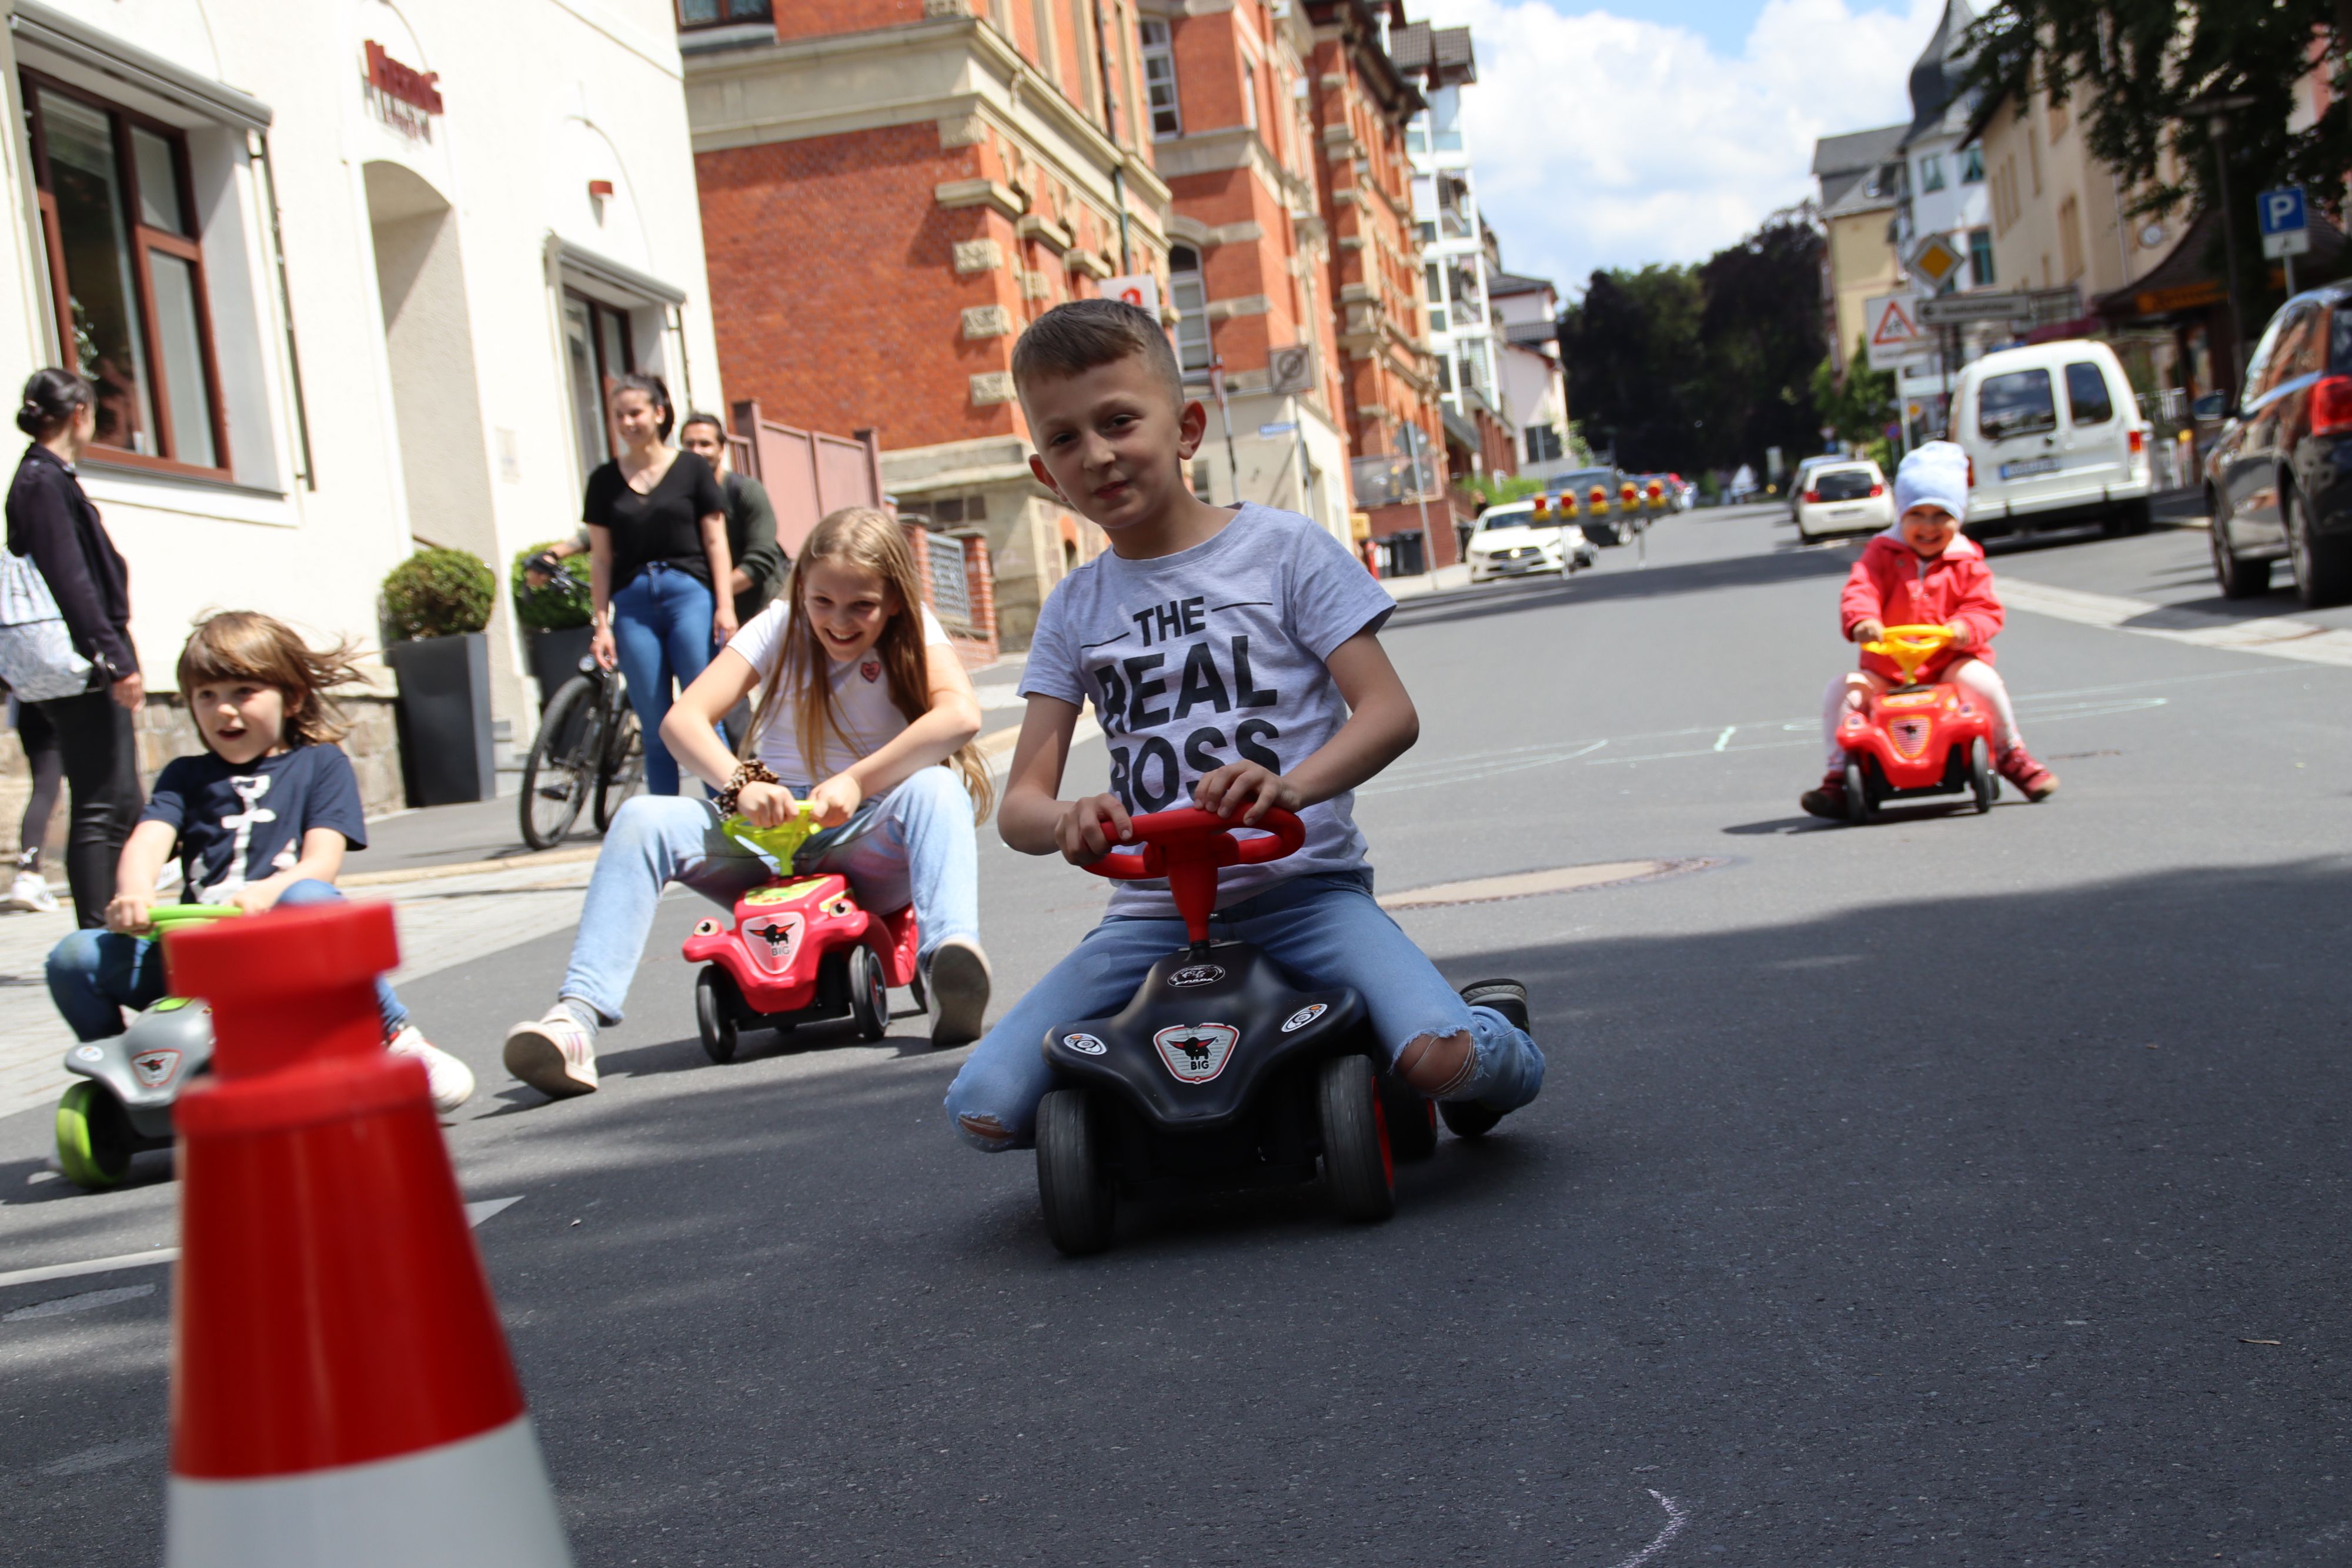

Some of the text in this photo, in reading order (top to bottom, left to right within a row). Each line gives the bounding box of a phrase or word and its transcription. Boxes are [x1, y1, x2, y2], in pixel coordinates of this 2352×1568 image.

[2268, 195, 2296, 229] P
[1133, 596, 1206, 647] THE
[1094, 635, 1278, 740] REAL
[1110, 718, 1281, 817] BOSS
[771, 946, 790, 956] BIG
[1191, 1061, 1210, 1070] BIG
